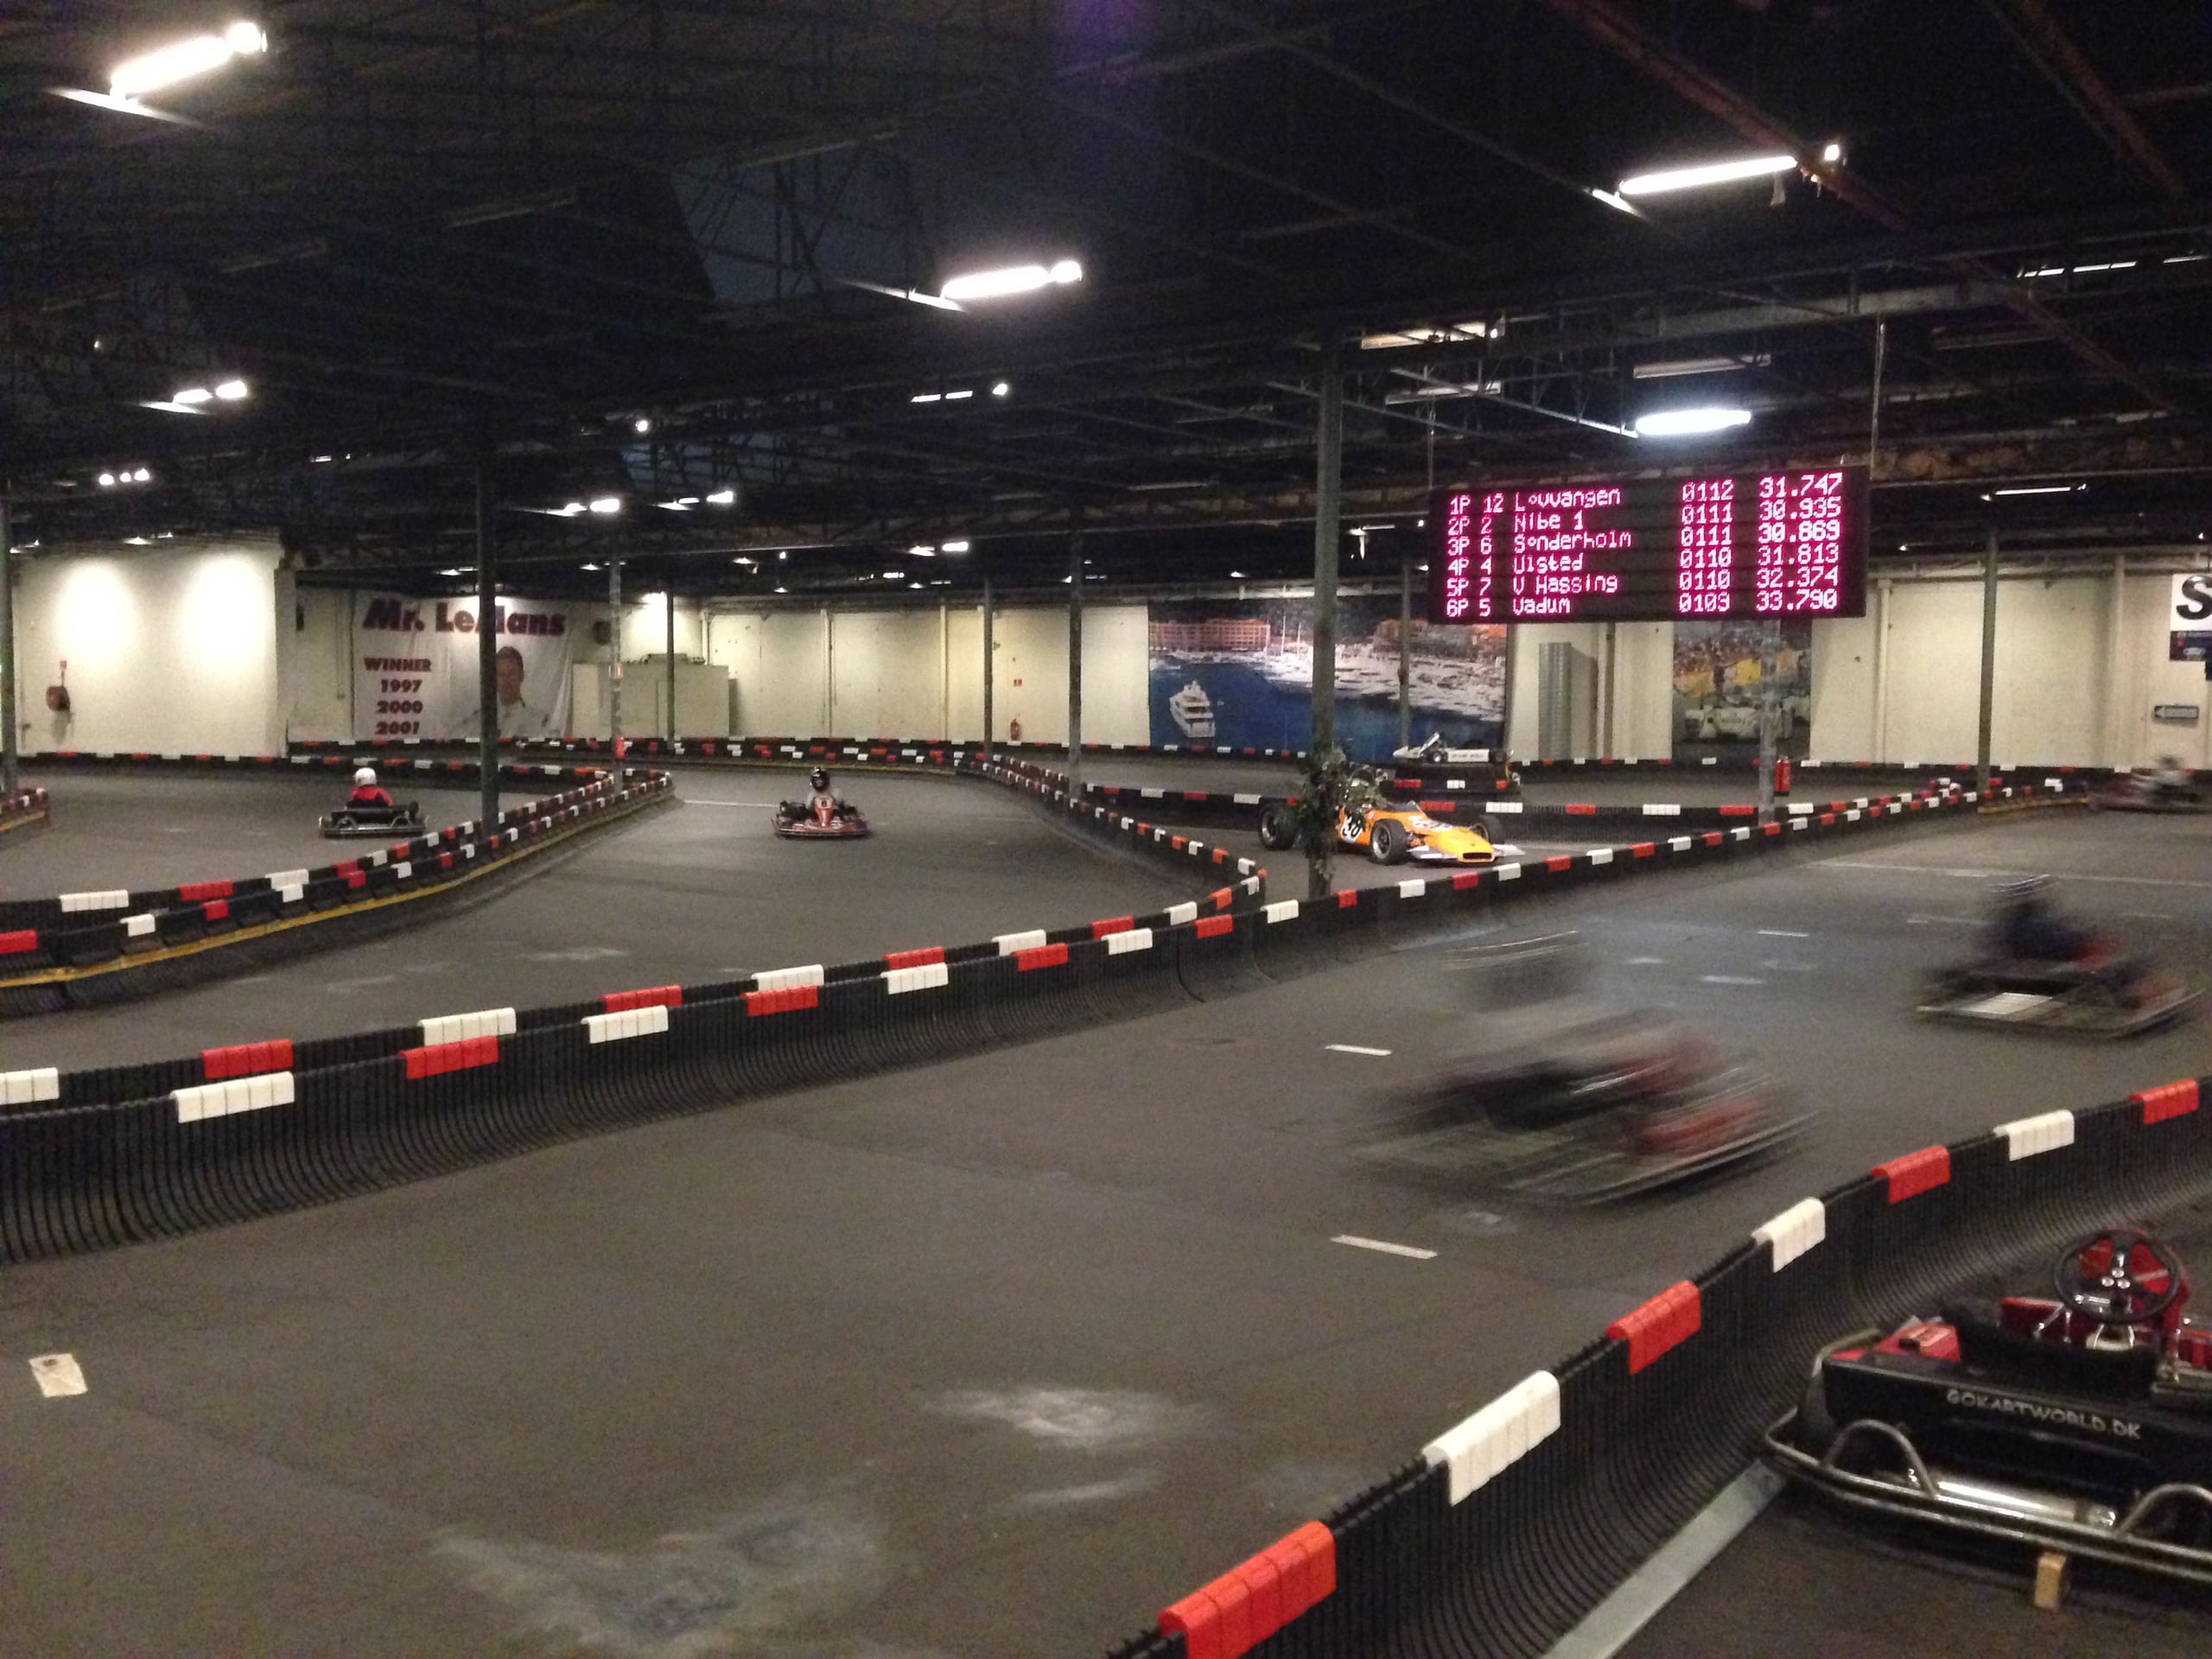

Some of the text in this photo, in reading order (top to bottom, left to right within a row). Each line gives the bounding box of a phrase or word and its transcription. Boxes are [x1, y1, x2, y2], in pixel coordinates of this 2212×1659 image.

[1450, 495, 1470, 514] 1P
[1484, 493, 1503, 512] 12
[1681, 480, 1733, 501] 0112
[1759, 472, 1842, 498] 31.747
[1448, 496, 1841, 535] 2P 2 Nibe 1 0111 30.935
[1447, 537, 1469, 556] 3P
[1480, 536, 1492, 554] 6
[1681, 524, 1732, 546] 0111
[1758, 519, 1840, 543] 30.869
[1446, 543, 1839, 575] 4P 4 Ulsted 0110 31.813
[1446, 565, 1838, 596] 5P 7 V Hassing 0110 32.374
[363, 599, 424, 632] Mr.
[1446, 598, 1468, 617] 6P
[1478, 598, 1491, 616] 5
[1512, 596, 1570, 615] Vadum
[1756, 588, 1837, 611] 33.790
[363, 657, 431, 671] WINNER
[381, 679, 422, 692] 1997
[376, 701, 423, 714] 2000
[375, 721, 419, 734] 2001
